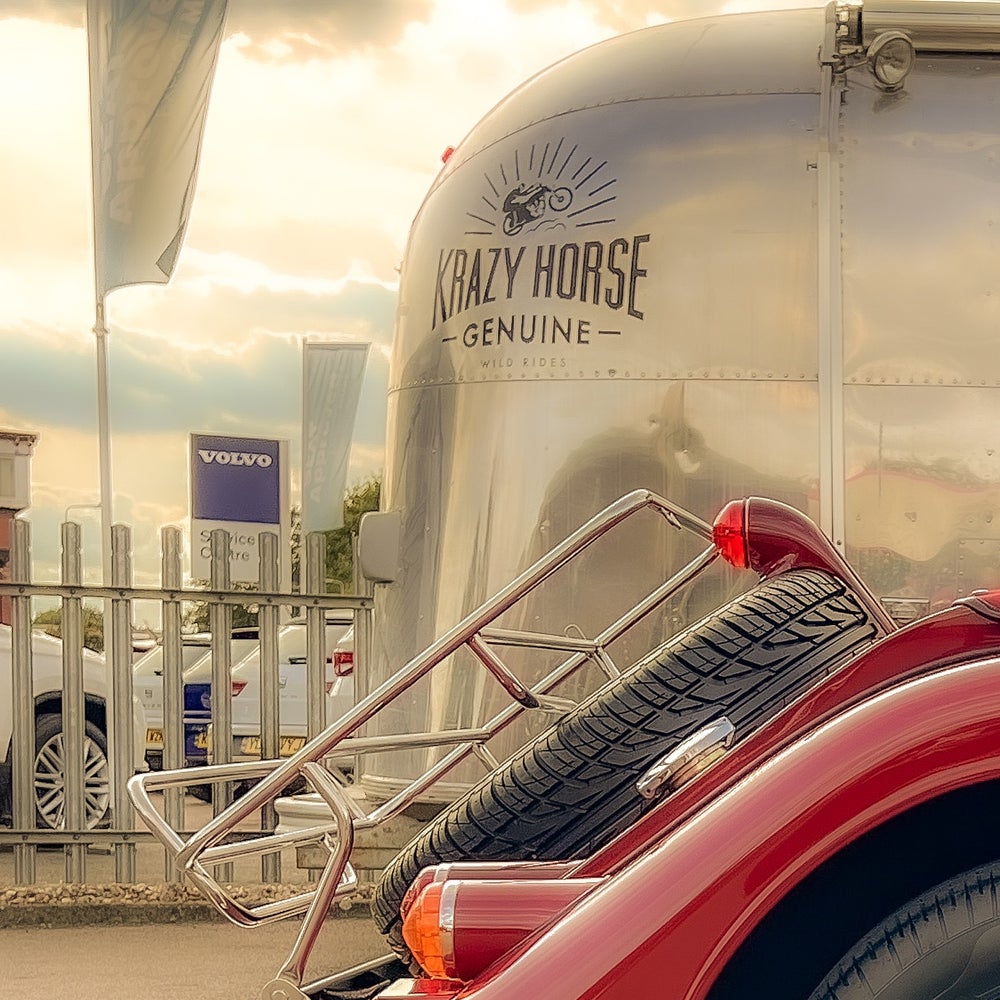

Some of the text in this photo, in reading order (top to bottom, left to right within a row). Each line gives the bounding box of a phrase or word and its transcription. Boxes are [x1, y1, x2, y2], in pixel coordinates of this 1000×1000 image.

[432, 233, 651, 331] KRAZY HORSE
[462, 314, 591, 348] GENUINE
[480, 357, 567, 368] WILD RIDES
[198, 449, 273, 468] VOLVO
[200, 530, 255, 545] Svice
[200, 546, 250, 561] Ctre
